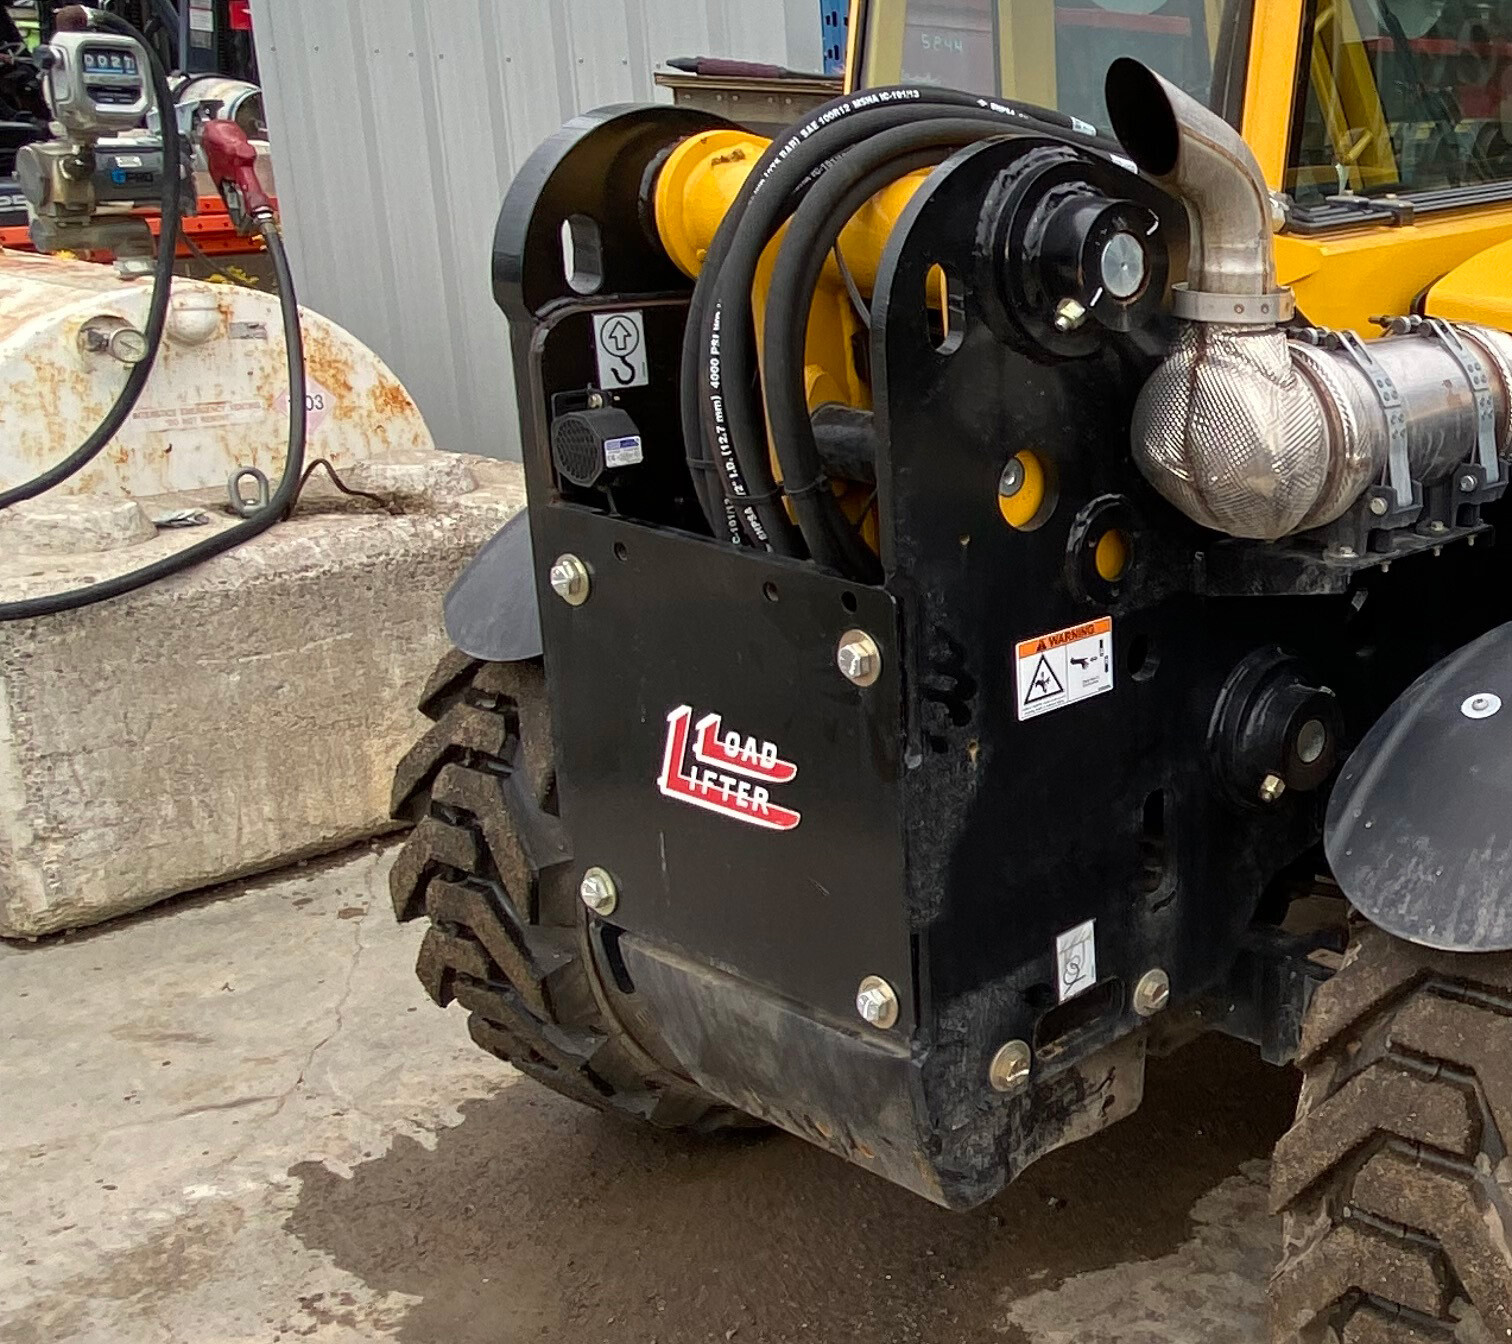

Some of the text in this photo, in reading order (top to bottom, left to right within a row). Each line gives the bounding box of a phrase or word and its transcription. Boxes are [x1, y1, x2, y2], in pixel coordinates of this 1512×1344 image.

[709, 357, 721, 390] 4000
[1047, 623, 1096, 648] WARNING
[656, 704, 801, 831] LIFTER
[692, 712, 798, 784] LOAD
